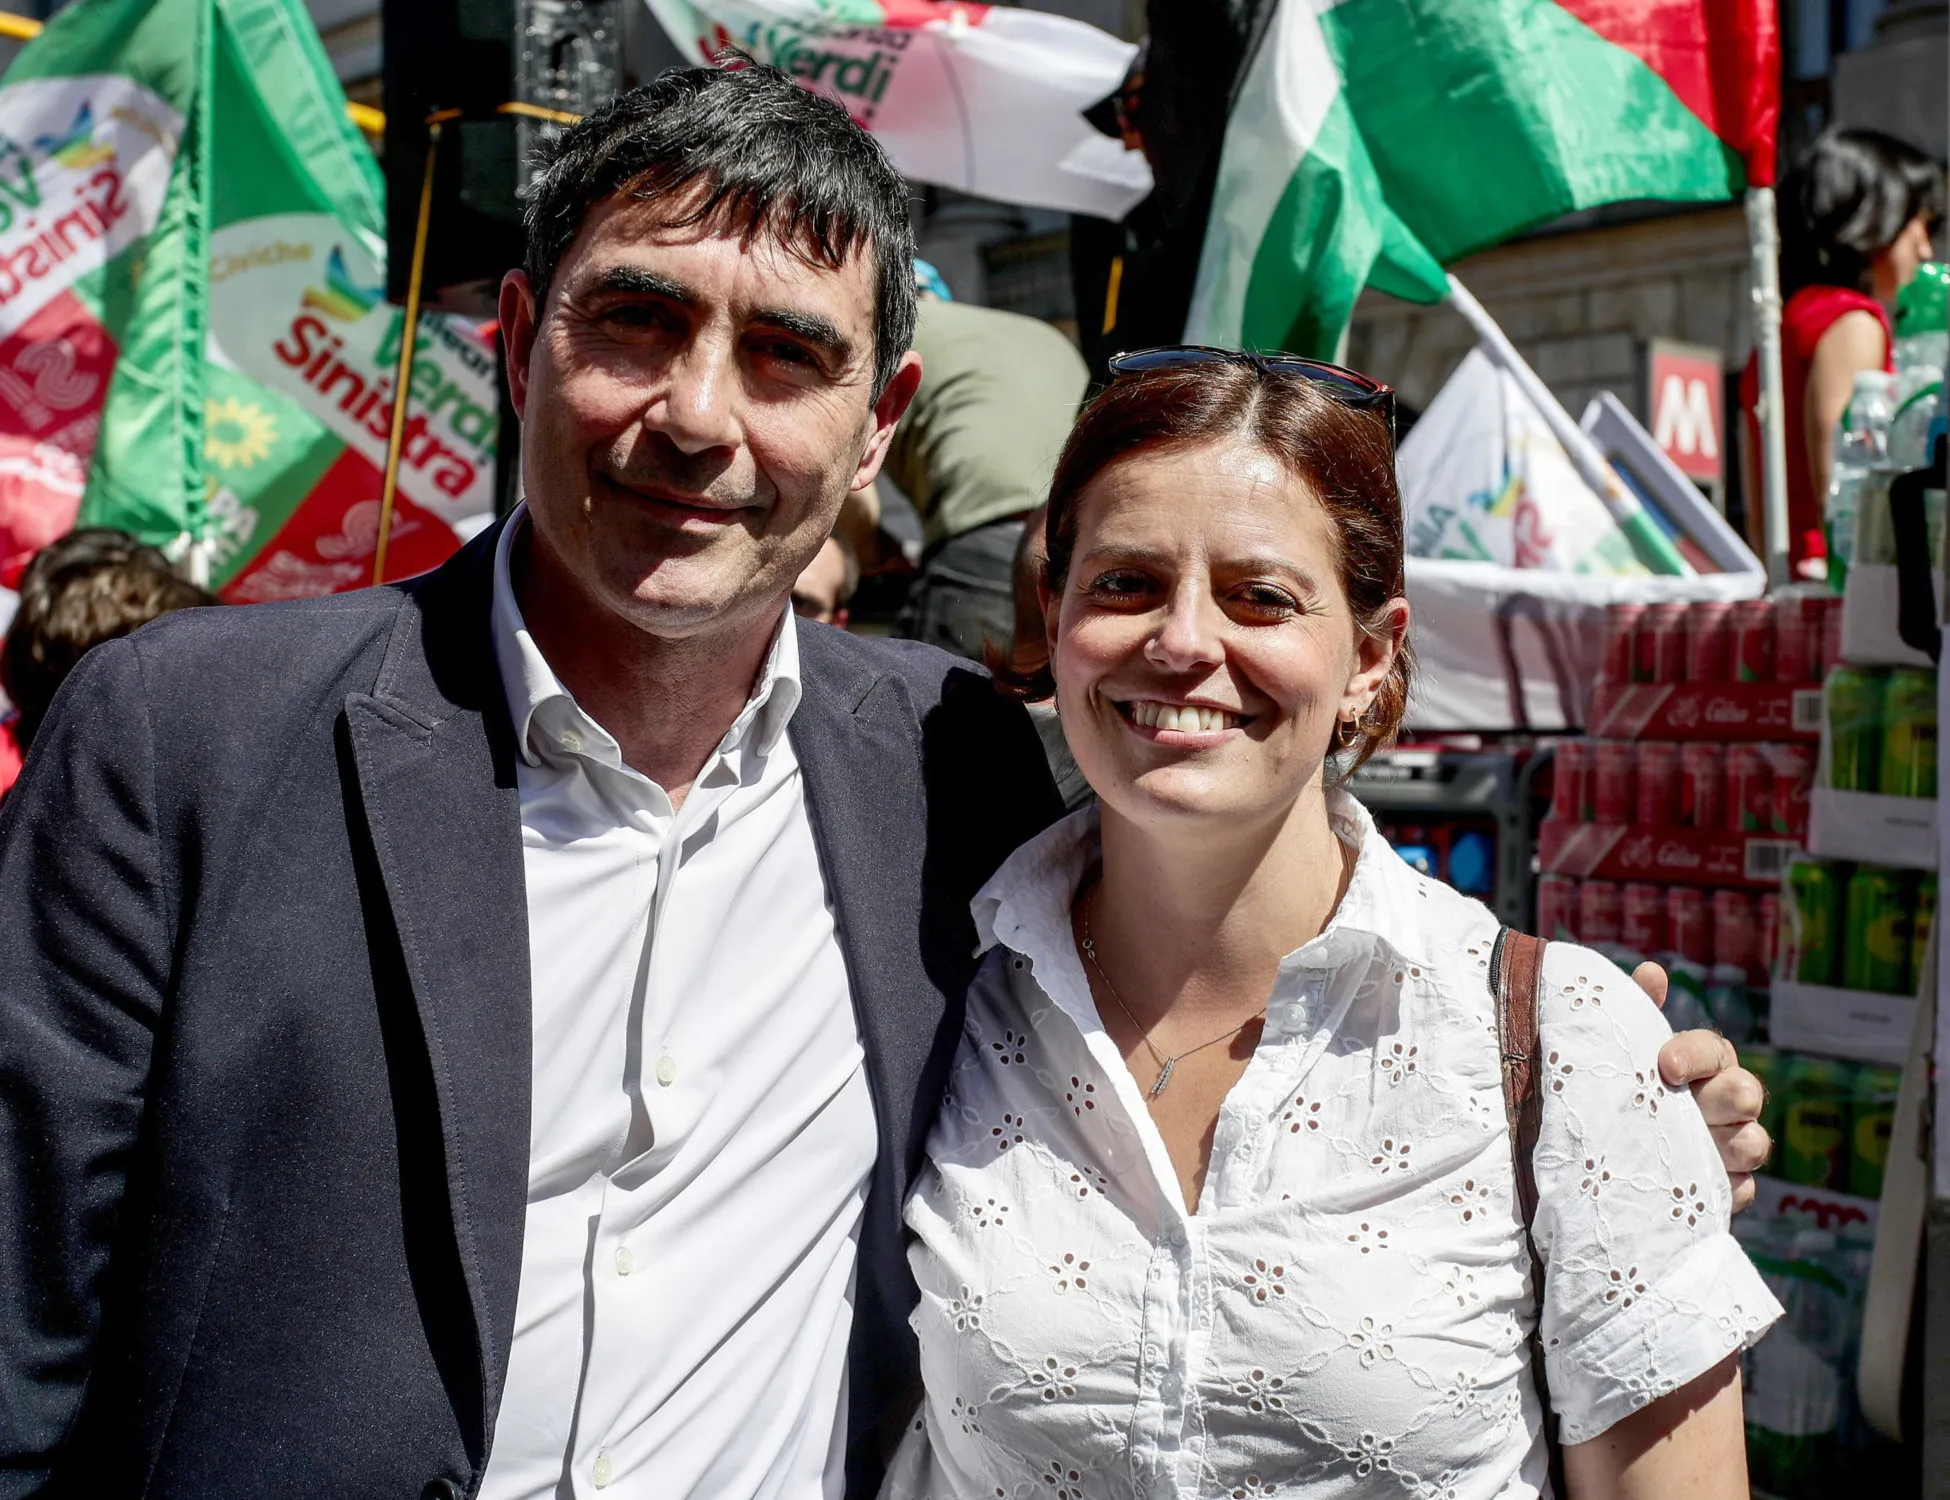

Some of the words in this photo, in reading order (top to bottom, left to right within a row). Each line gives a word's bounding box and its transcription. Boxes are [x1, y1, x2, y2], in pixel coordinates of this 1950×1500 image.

[765, 29, 899, 104] Verdi
[272, 314, 478, 502] Sinistra
[1654, 372, 1719, 460] M
